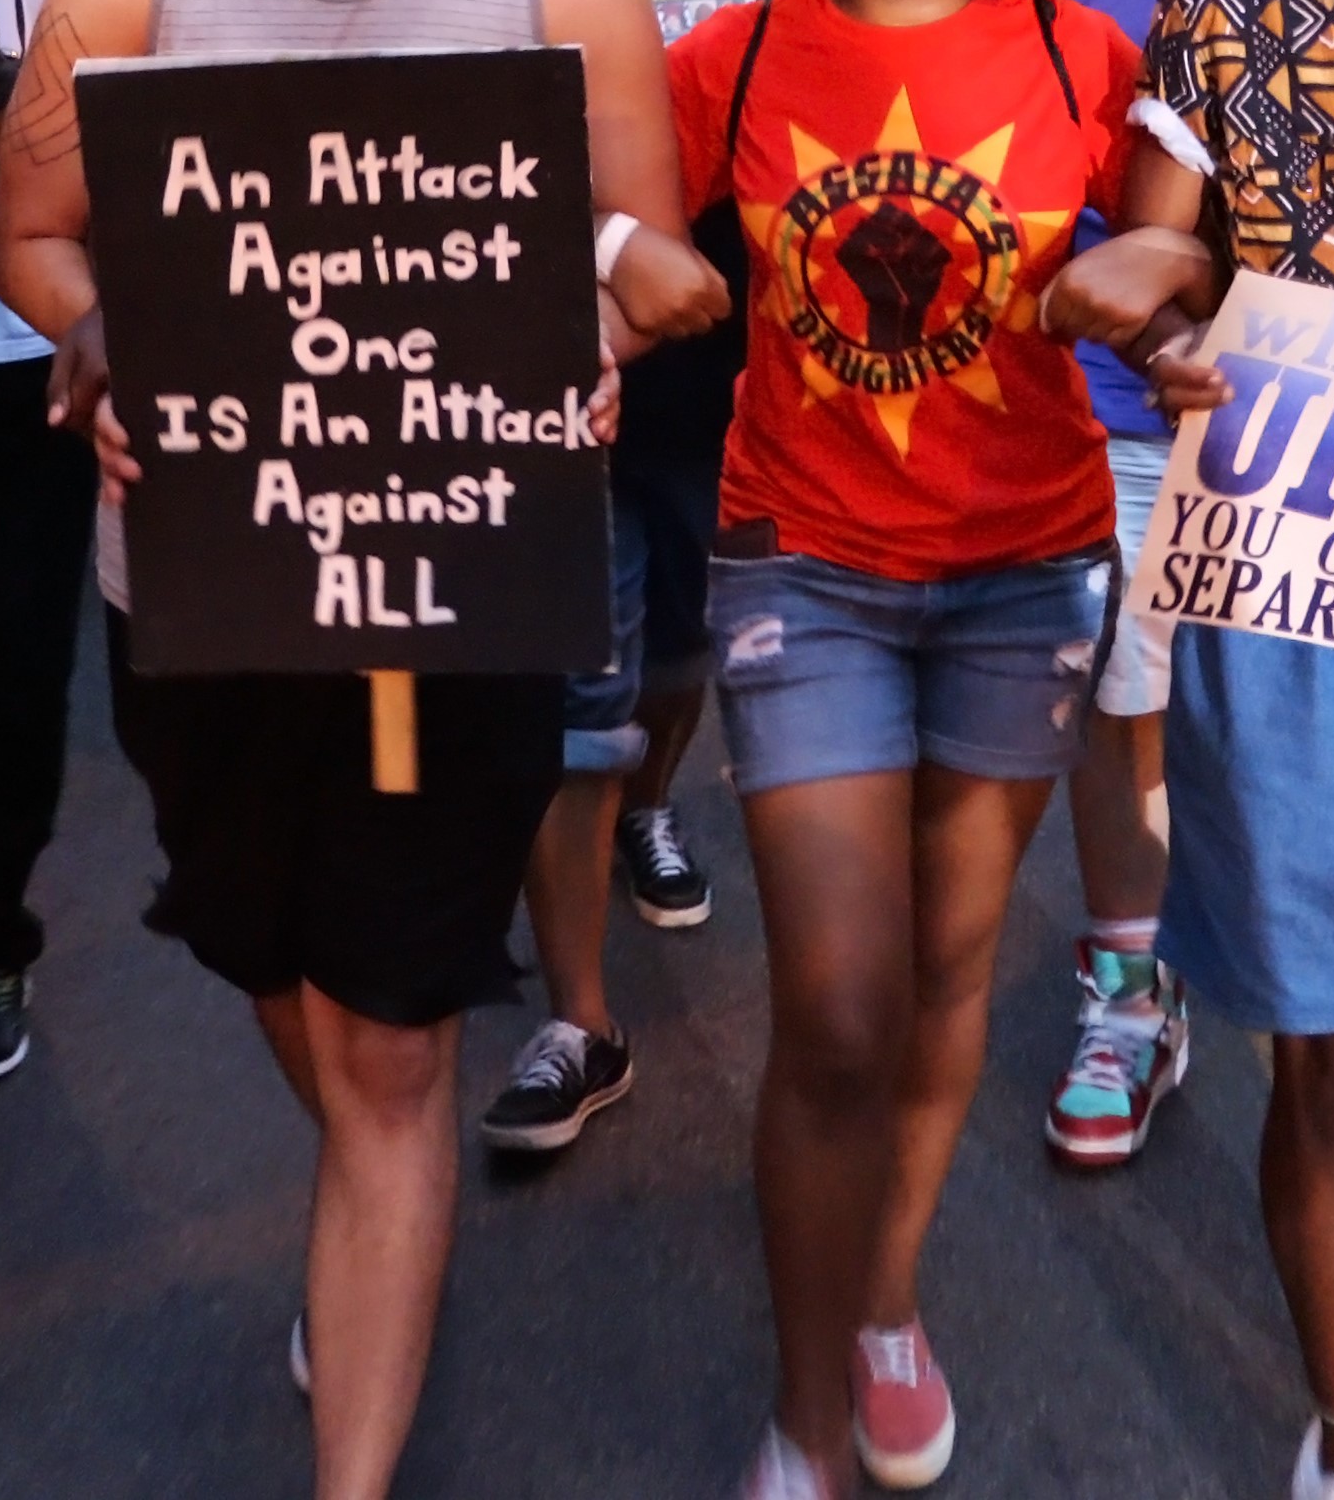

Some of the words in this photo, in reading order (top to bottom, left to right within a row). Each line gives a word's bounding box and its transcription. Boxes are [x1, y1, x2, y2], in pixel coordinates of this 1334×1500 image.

[162, 136, 271, 216] An
[309, 131, 540, 204] Attack
[229, 221, 521, 320] Against
[292, 318, 437, 375] One
[789, 306, 993, 394] DAUGHTERS
[281, 382, 370, 446] An
[400, 379, 600, 450] Attack
[253, 459, 516, 554] Against
[1169, 493, 1285, 558] YOU
[315, 555, 457, 628] ALL
